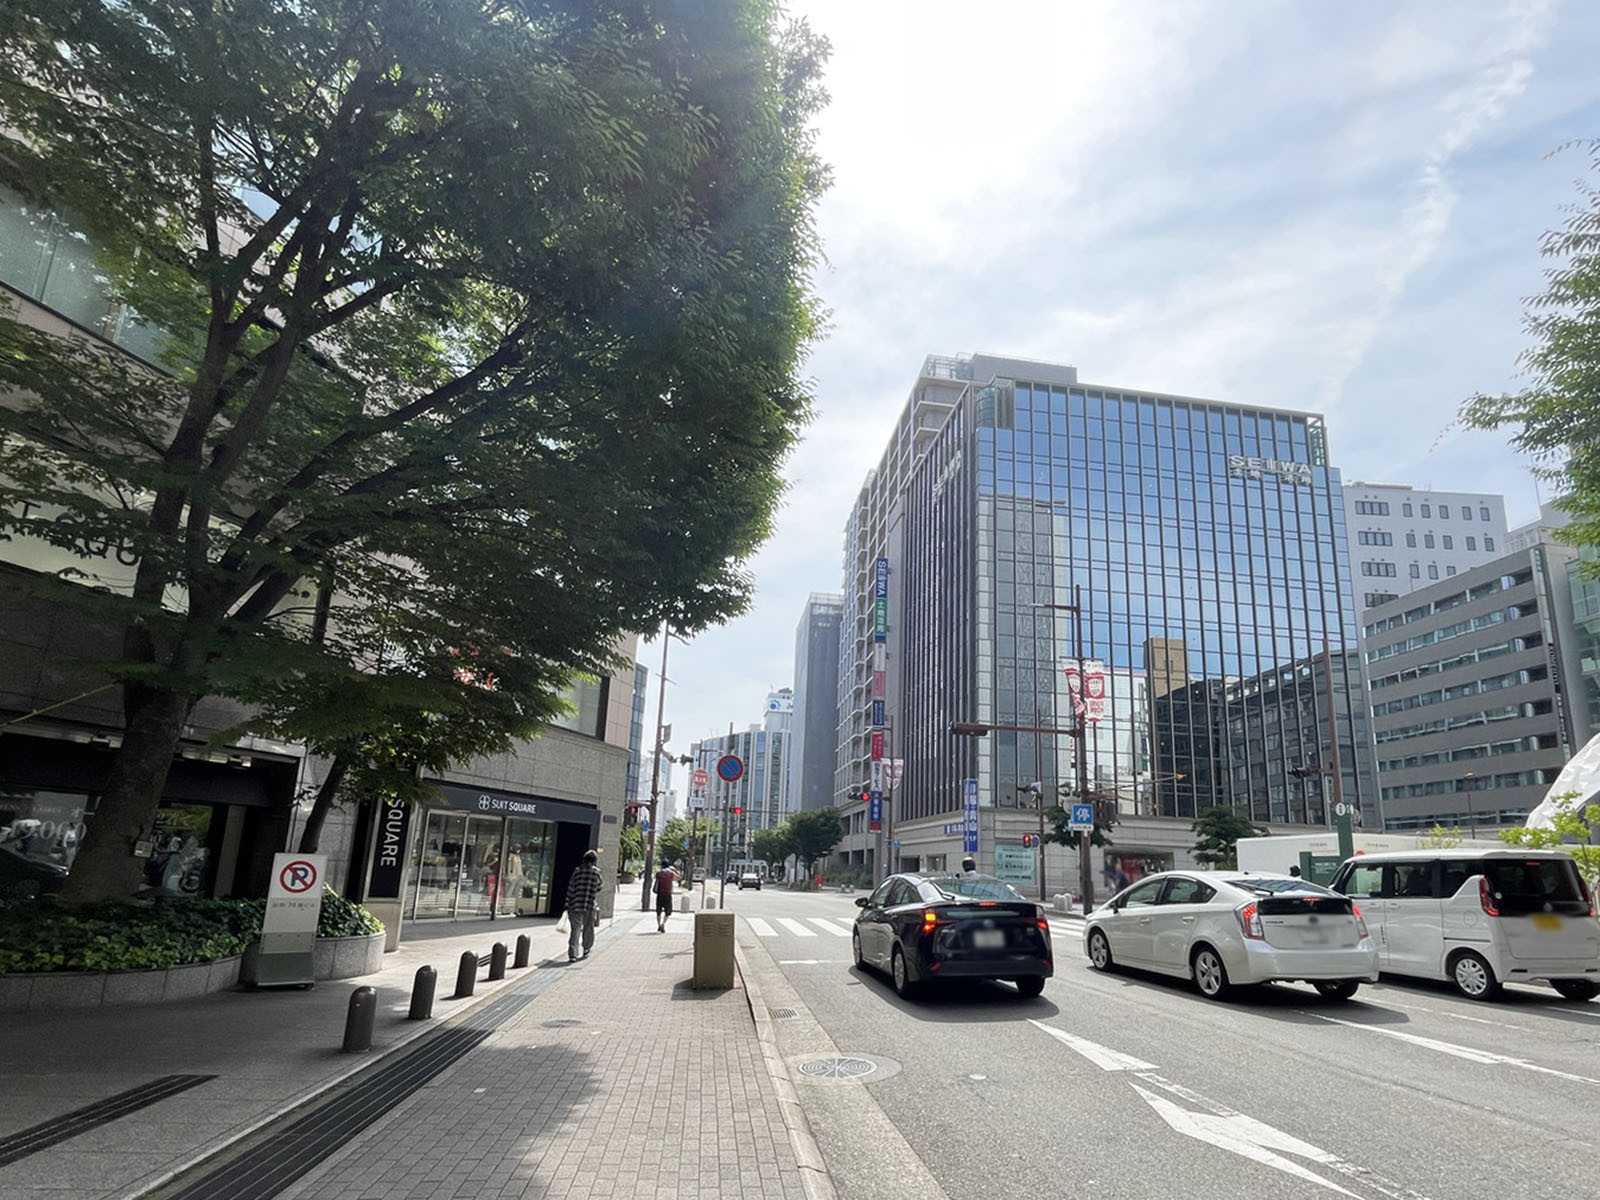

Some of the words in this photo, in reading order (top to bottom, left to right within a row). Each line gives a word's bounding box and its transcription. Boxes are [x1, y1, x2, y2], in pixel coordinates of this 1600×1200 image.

[1230, 456, 1311, 474] SEIWA
[491, 799, 508, 811] SUIT
[508, 803, 537, 814] SQUARE
[1075, 807, 1090, 822] 停
[380, 798, 405, 867] SQUARE
